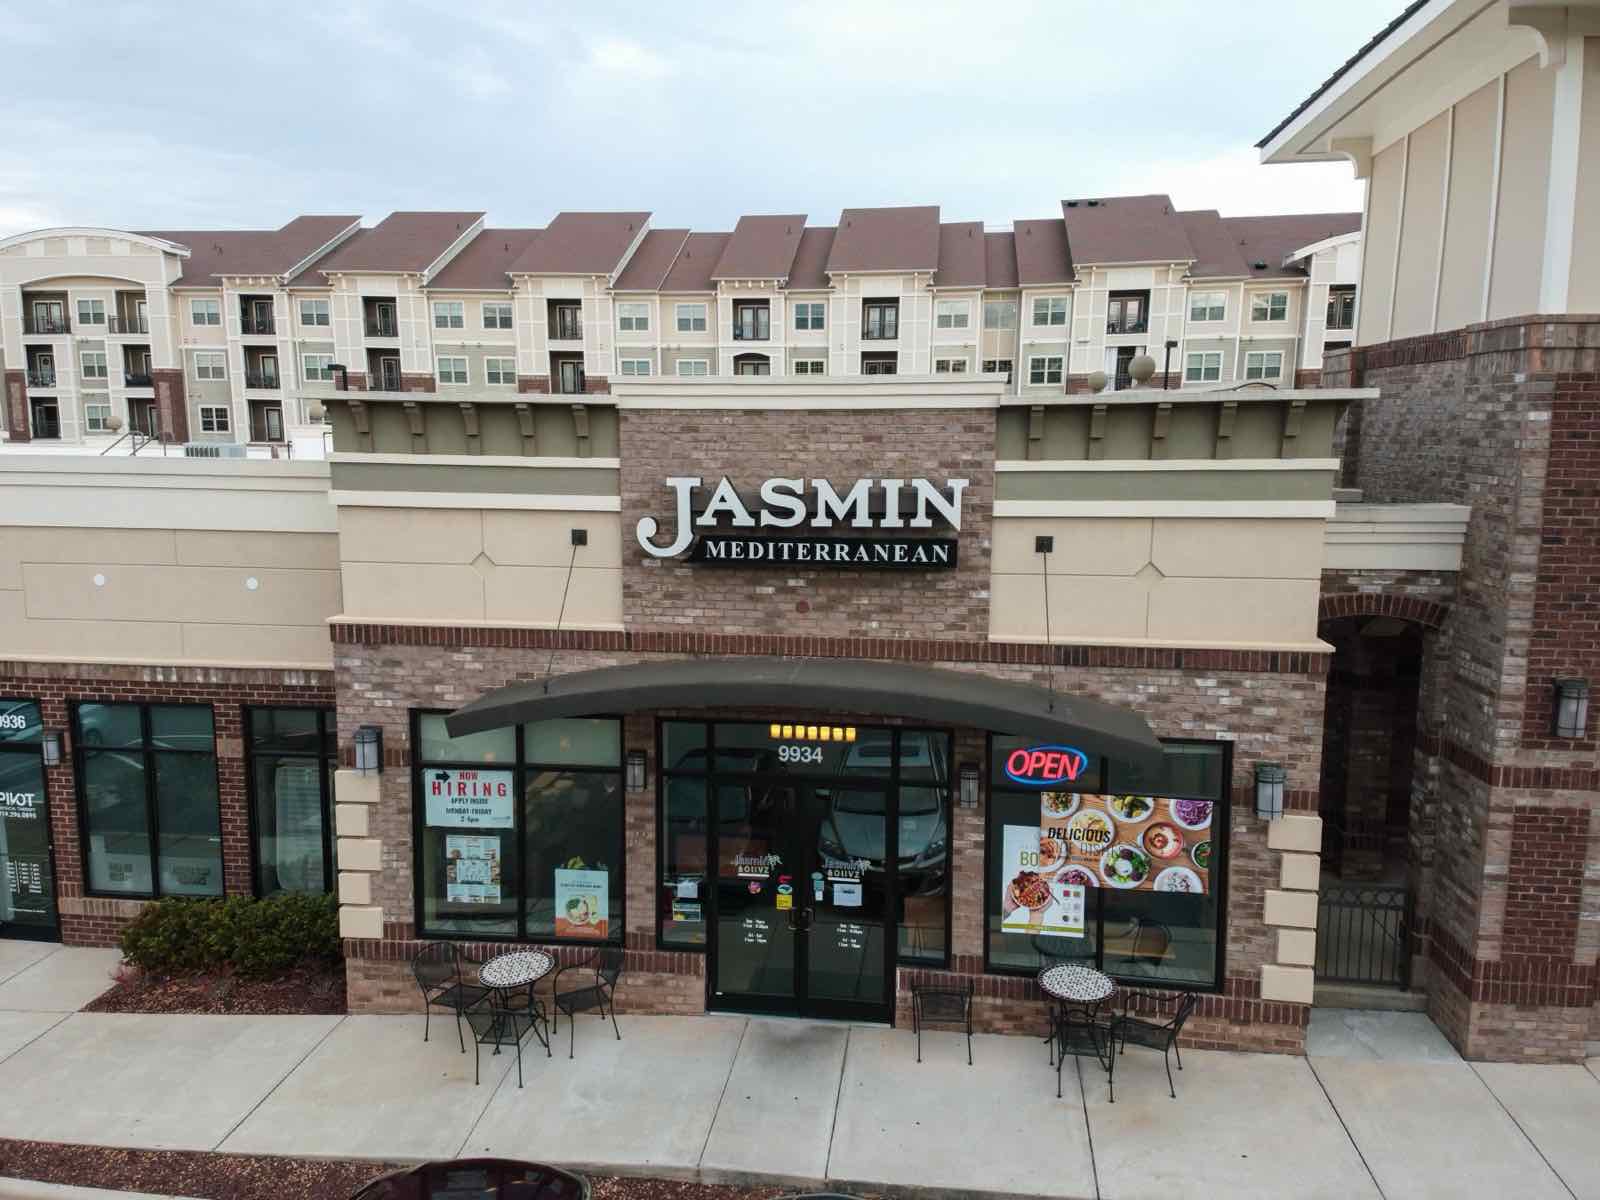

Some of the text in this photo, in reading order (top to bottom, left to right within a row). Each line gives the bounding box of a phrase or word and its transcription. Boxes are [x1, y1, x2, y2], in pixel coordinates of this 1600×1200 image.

[637, 475, 969, 557] JASMIN
[705, 540, 949, 563] MEDITERRANEAN
[778, 745, 823, 763] 9934
[1007, 749, 1081, 780] OPEN
[458, 771, 479, 780] NOW
[432, 780, 507, 797] HIRING
[1047, 827, 1111, 843] DELICIOUS
